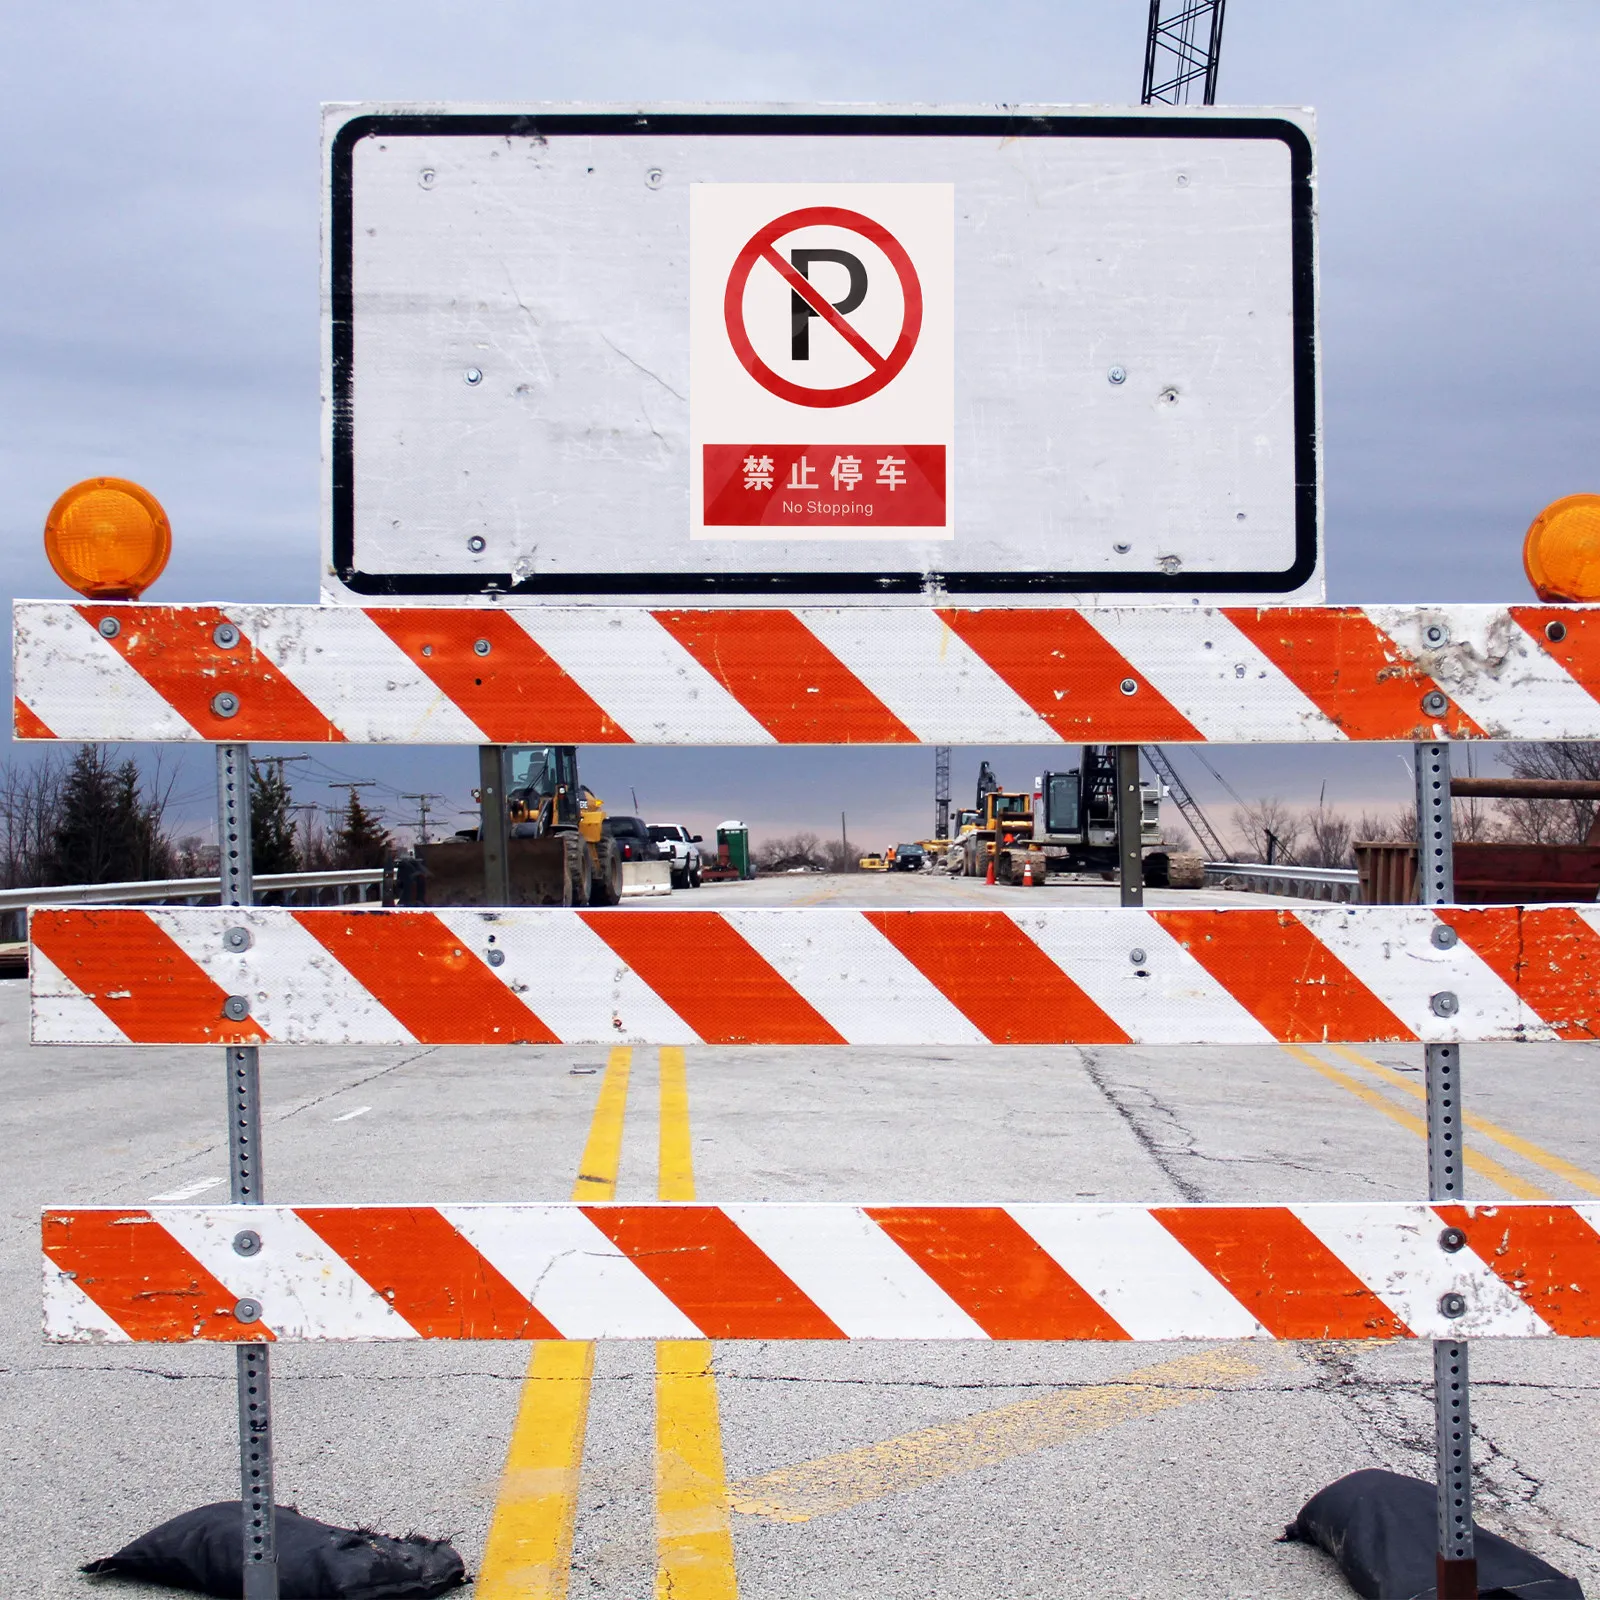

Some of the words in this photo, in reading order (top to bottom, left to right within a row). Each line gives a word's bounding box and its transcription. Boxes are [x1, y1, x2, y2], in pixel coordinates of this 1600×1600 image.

[791, 249, 867, 361] P
[743, 455, 907, 492] 禁止停车
[782, 501, 803, 515] No
[807, 501, 874, 518] Stopping
